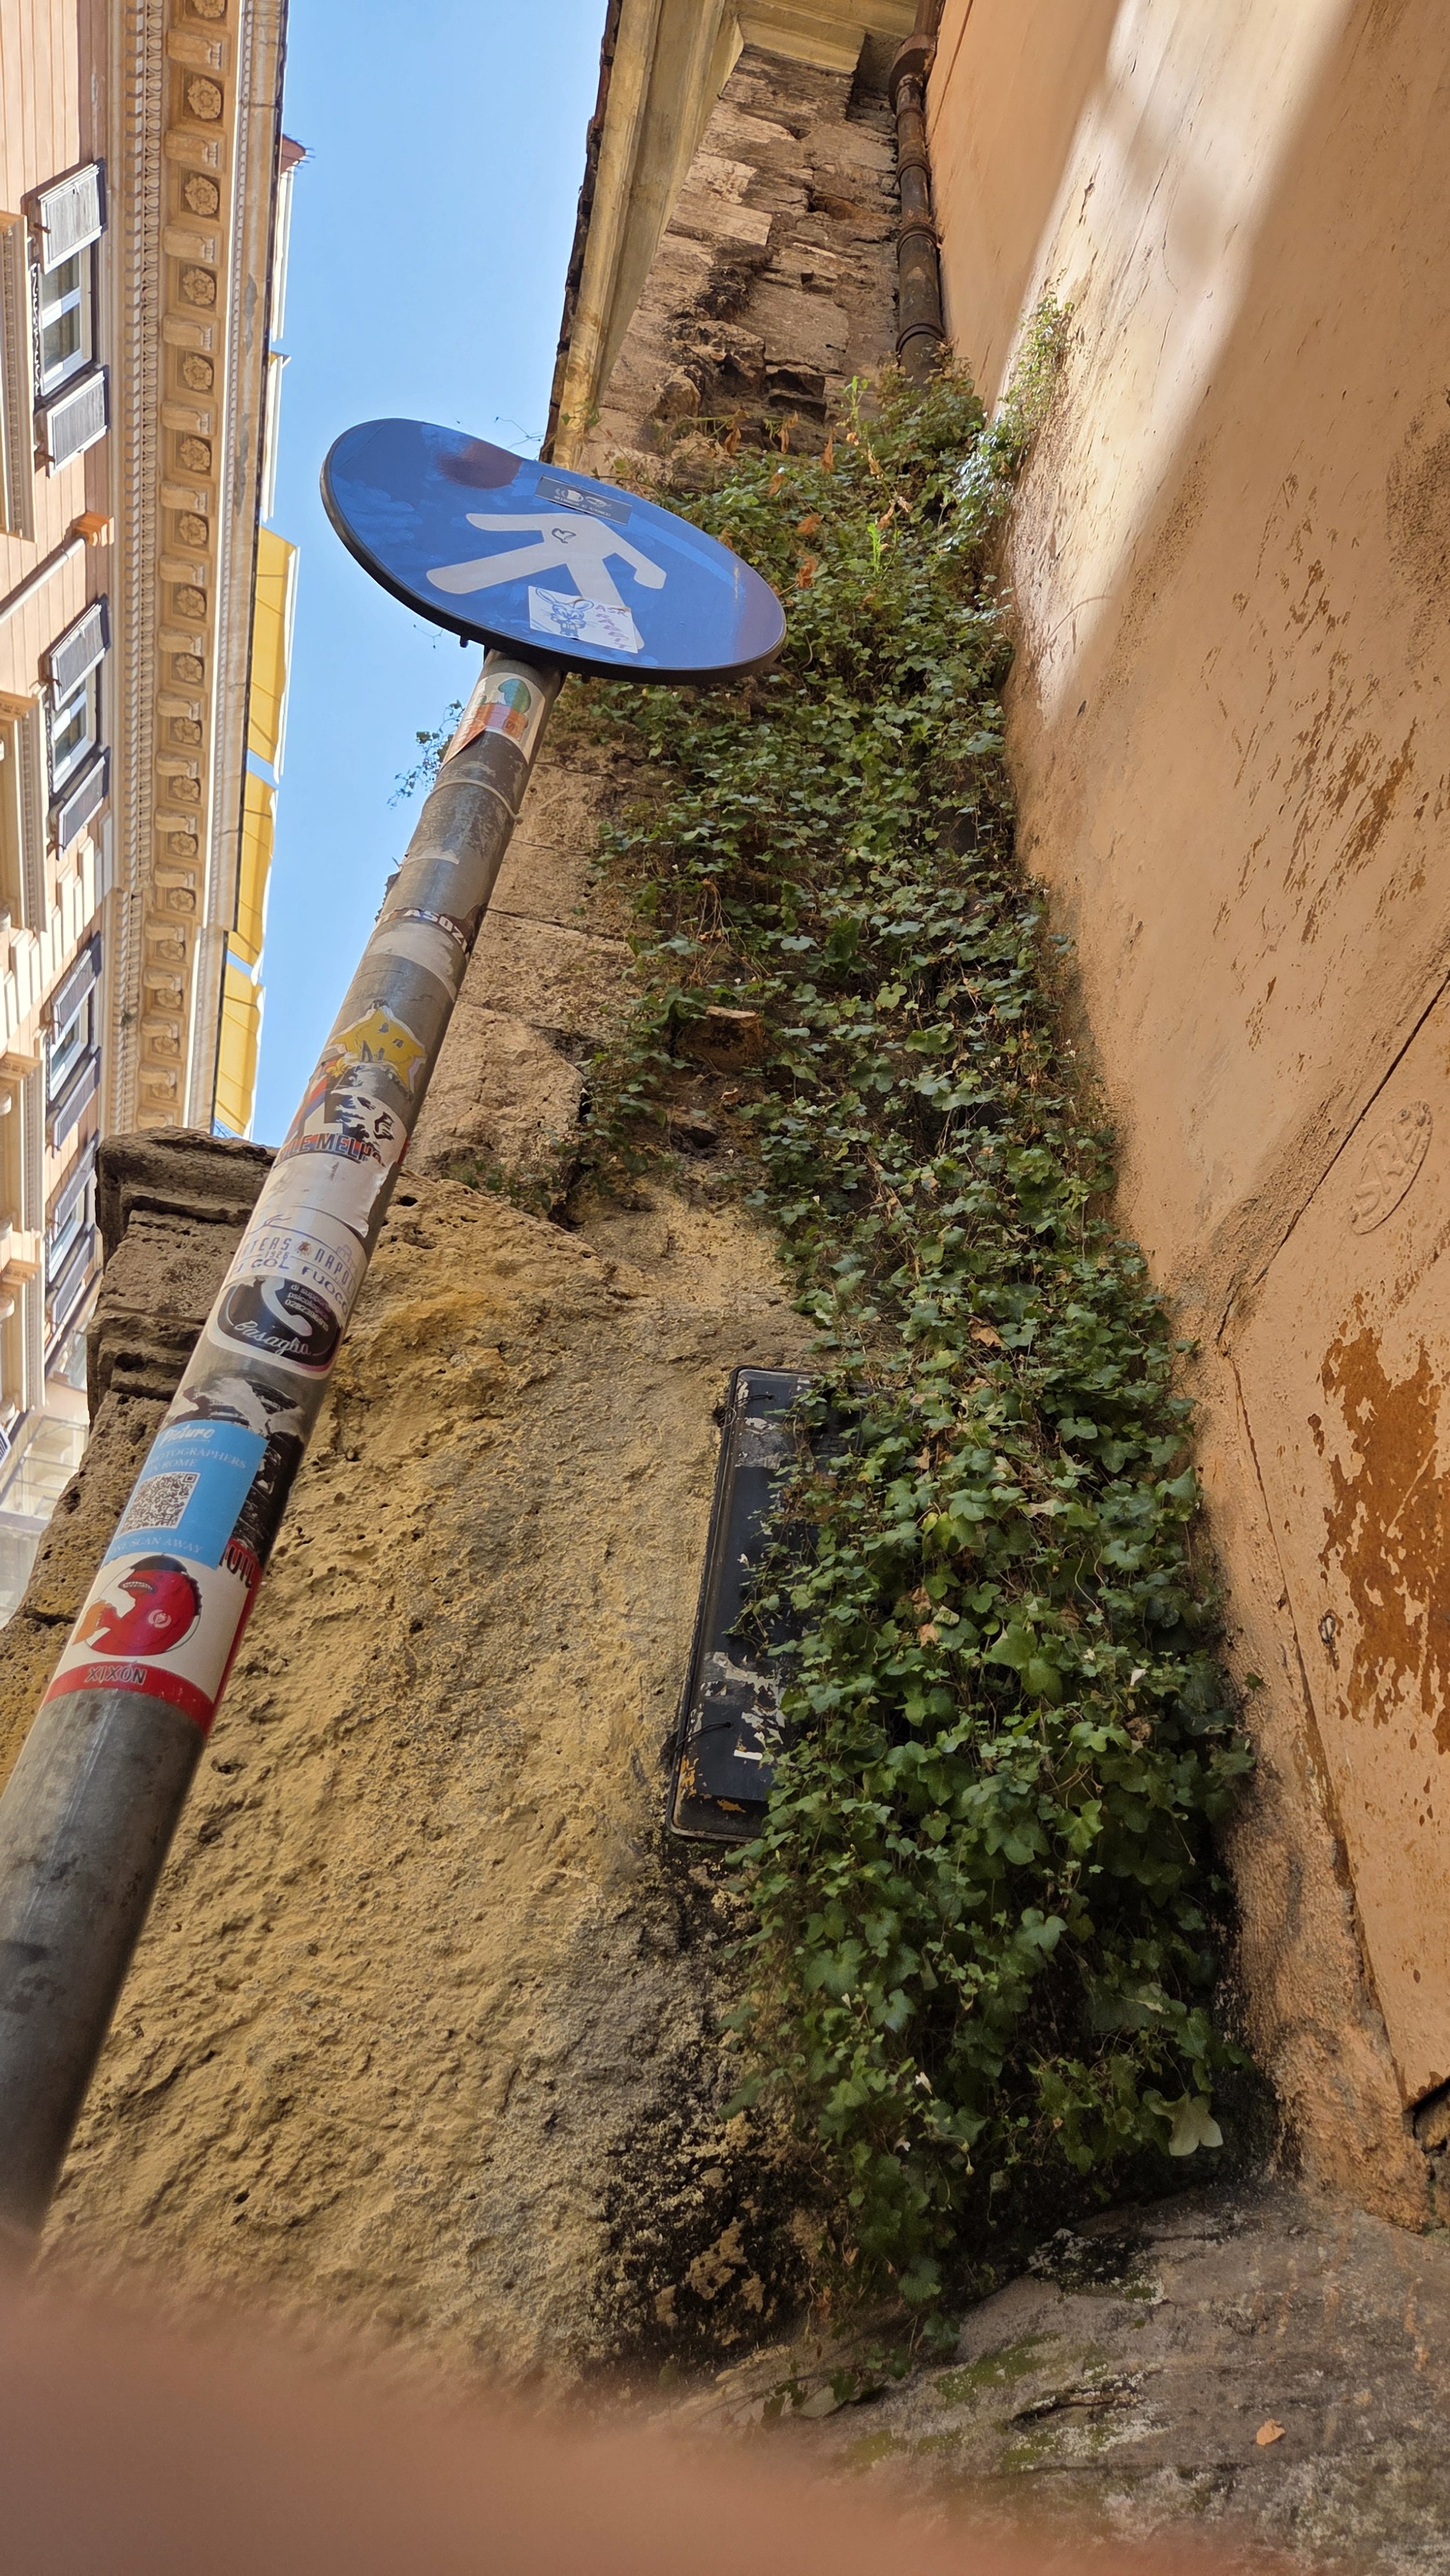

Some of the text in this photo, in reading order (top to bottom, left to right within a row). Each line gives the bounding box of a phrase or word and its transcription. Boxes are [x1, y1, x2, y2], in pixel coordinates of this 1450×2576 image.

[264, 1250, 290, 1261] 1926
[234, 1320, 312, 1355] Basaglia
[162, 1459, 197, 1470] ROME
[130, 1536, 162, 1547] SCAN
[164, 1538, 203, 1554] AWAY
[84, 1660, 148, 1685] XIXÓN
